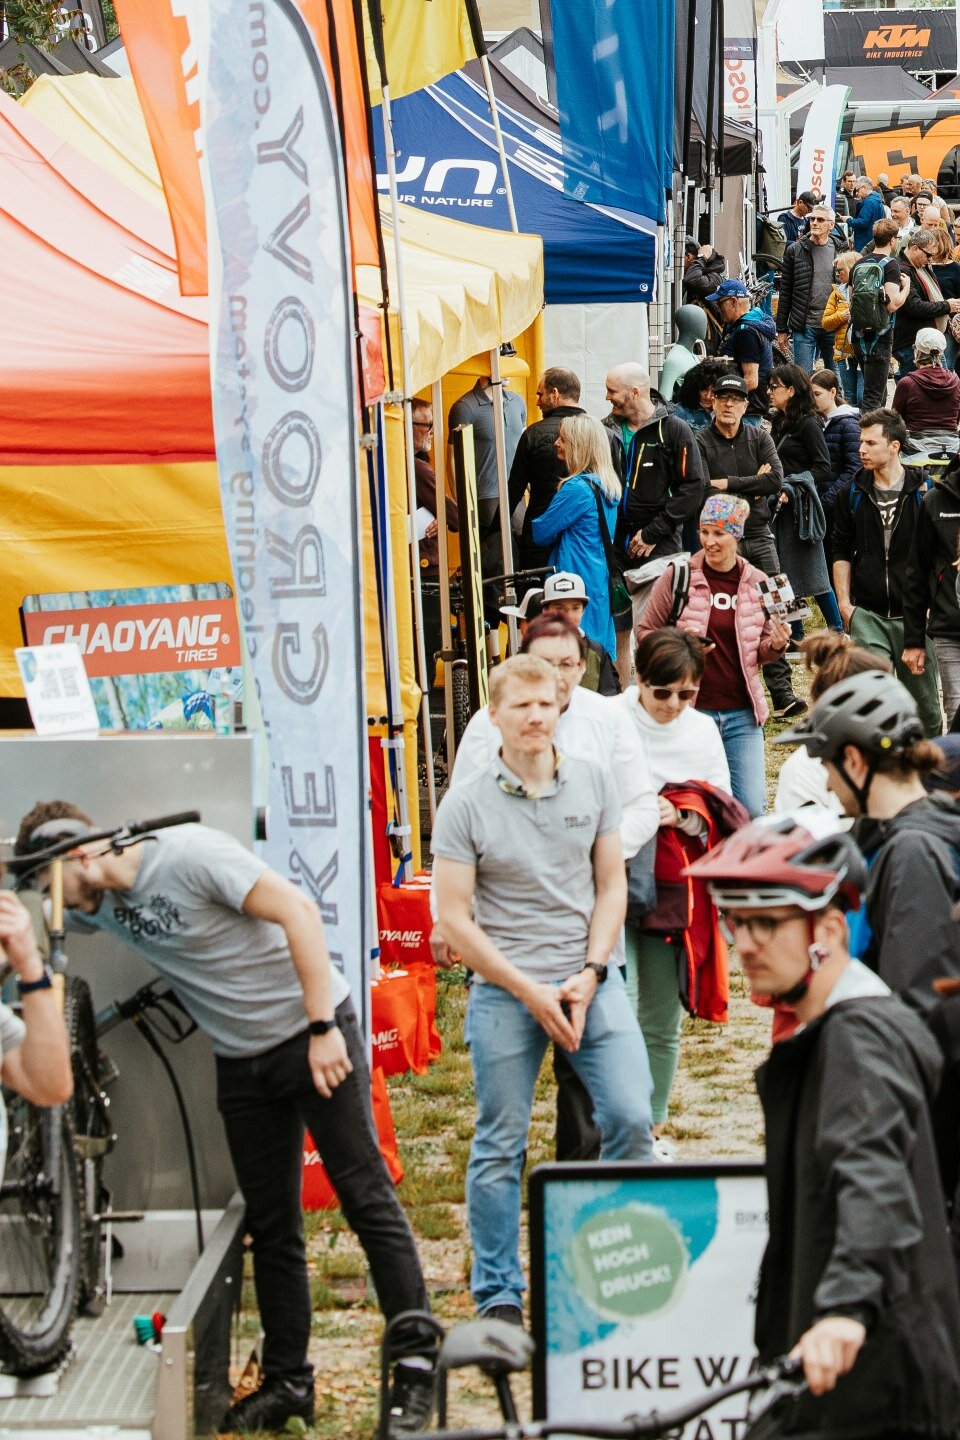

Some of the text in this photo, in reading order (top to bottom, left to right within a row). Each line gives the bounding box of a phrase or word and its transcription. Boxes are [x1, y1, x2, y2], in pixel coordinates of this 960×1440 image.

[863, 24, 931, 49] KTM
[866, 50, 923, 59] BIKE INDUSTRIES
[811, 149, 826, 201] OSCH
[421, 196, 494, 208] NATURE
[43, 614, 221, 654] CHAOYANG
[176, 648, 218, 664] TIRES
[379, 930, 422, 942] OYANG
[587, 1222, 634, 1249] KEIN
[593, 1243, 650, 1273] HOCH
[581, 1357, 681, 1391] BIKE
